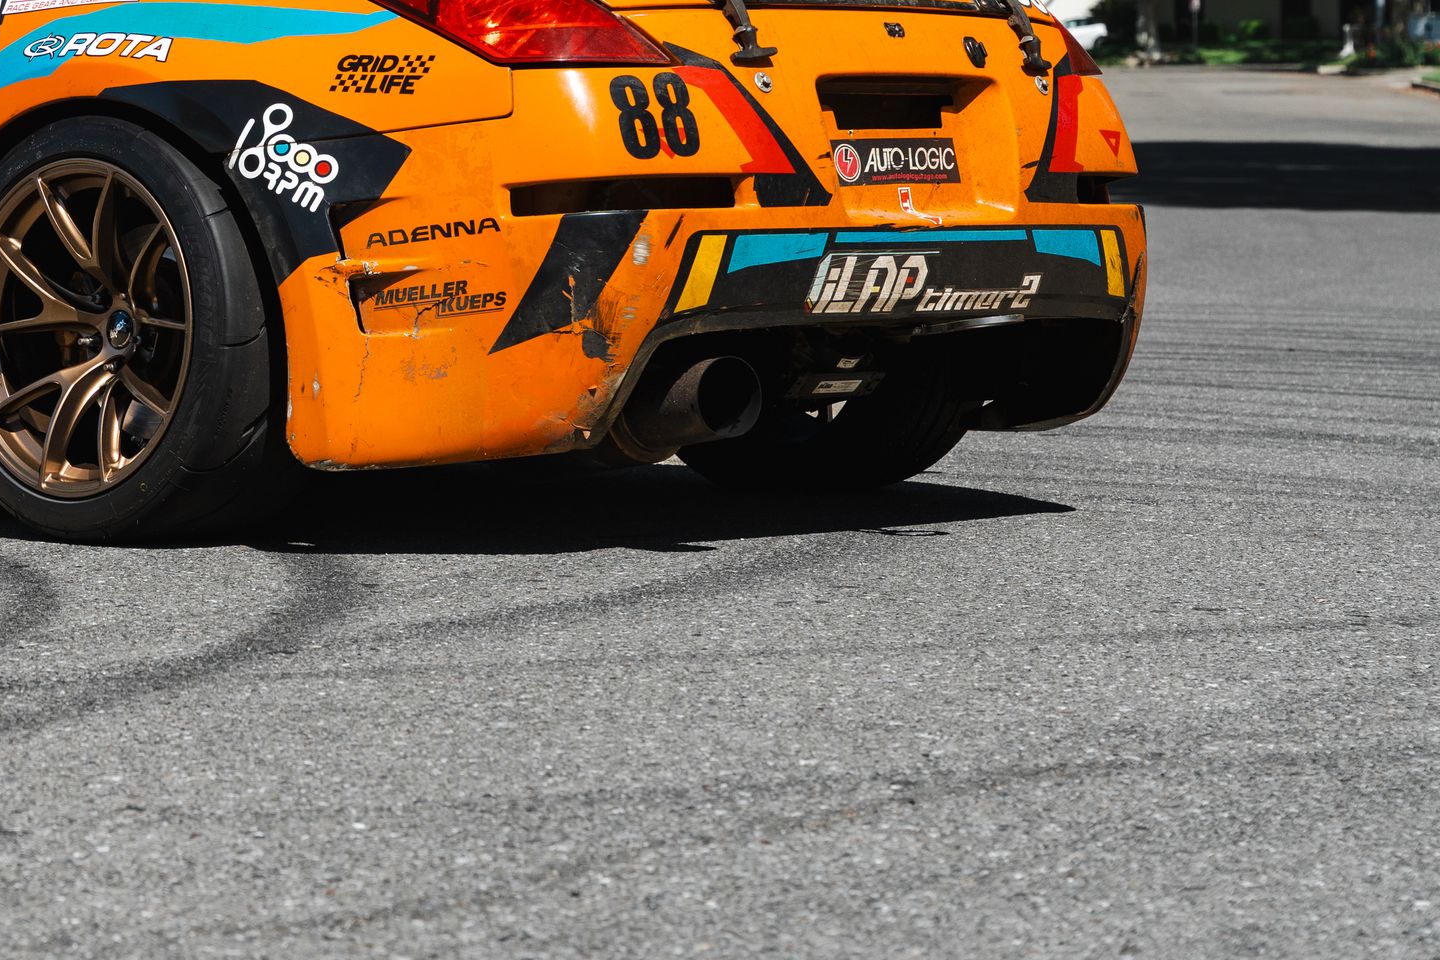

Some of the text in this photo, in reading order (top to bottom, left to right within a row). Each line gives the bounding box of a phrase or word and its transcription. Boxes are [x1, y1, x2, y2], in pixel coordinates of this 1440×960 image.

[6, 2, 30, 13] RACE
[32, 0, 58, 10] GEAR
[57, 32, 174, 63] ROTA
[337, 54, 400, 73] GRID
[363, 74, 424, 95] LIFE
[608, 72, 702, 160] 88
[863, 147, 955, 173] AUTO-LOGIC
[366, 217, 501, 250] ADENNA
[374, 280, 468, 306] MUELLER
[441, 291, 507, 313] KUEPS
